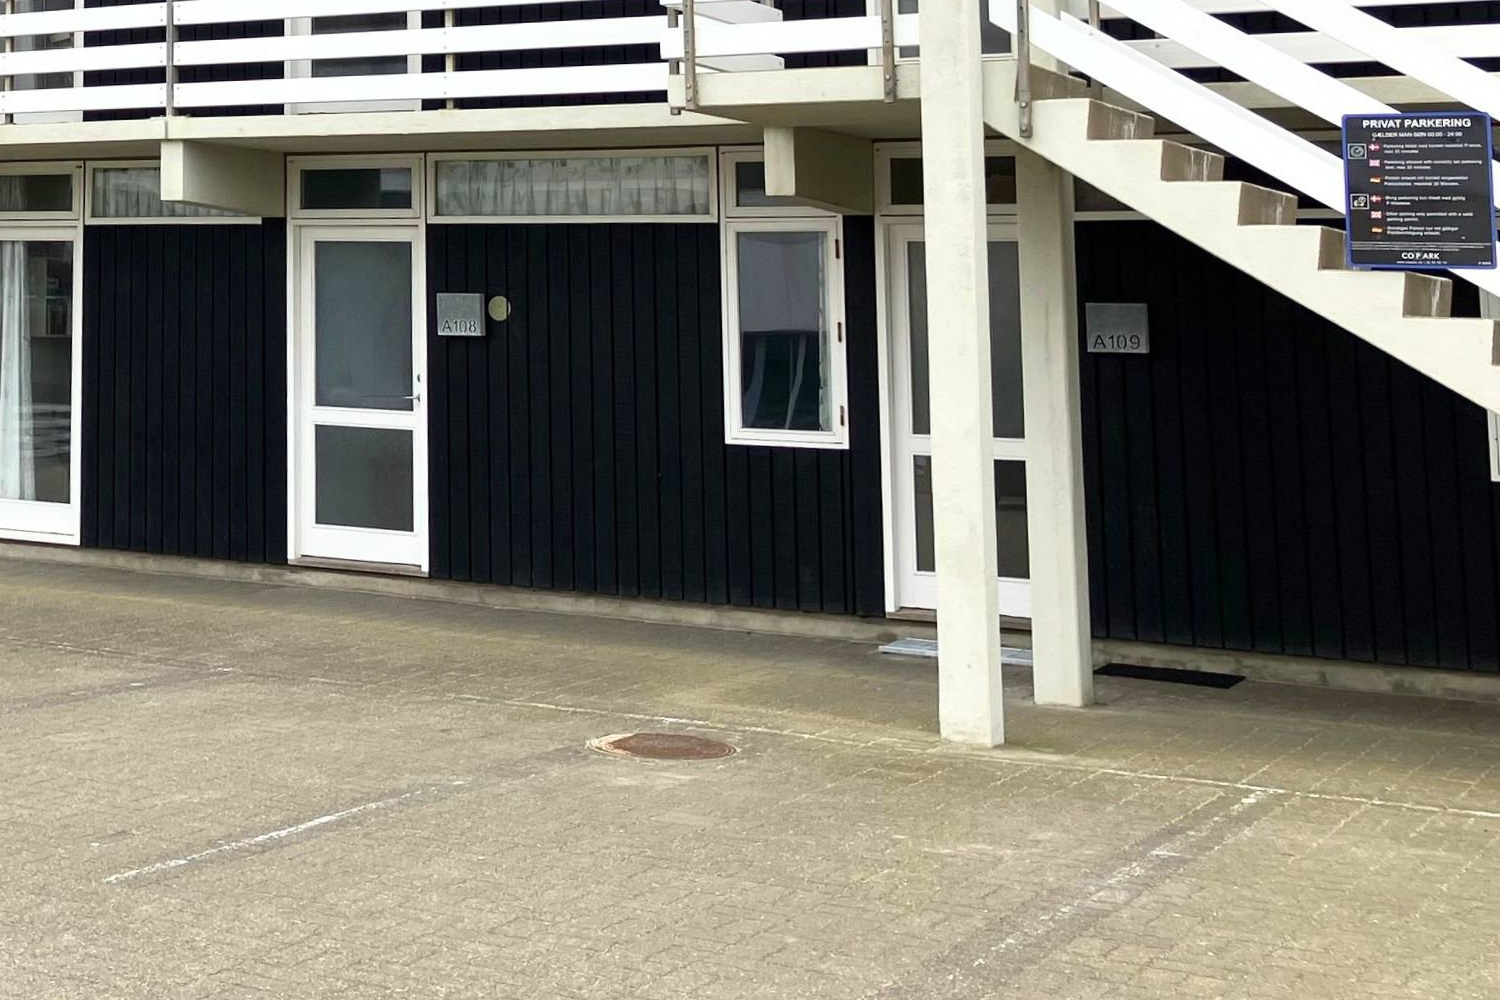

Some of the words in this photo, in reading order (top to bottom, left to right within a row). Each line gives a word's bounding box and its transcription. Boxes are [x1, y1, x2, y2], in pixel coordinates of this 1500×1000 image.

[1362, 119, 1402, 129] PRIVAT
[1404, 118, 1472, 128] PARKERING
[442, 319, 477, 333] A108
[1093, 334, 1141, 350] A109
